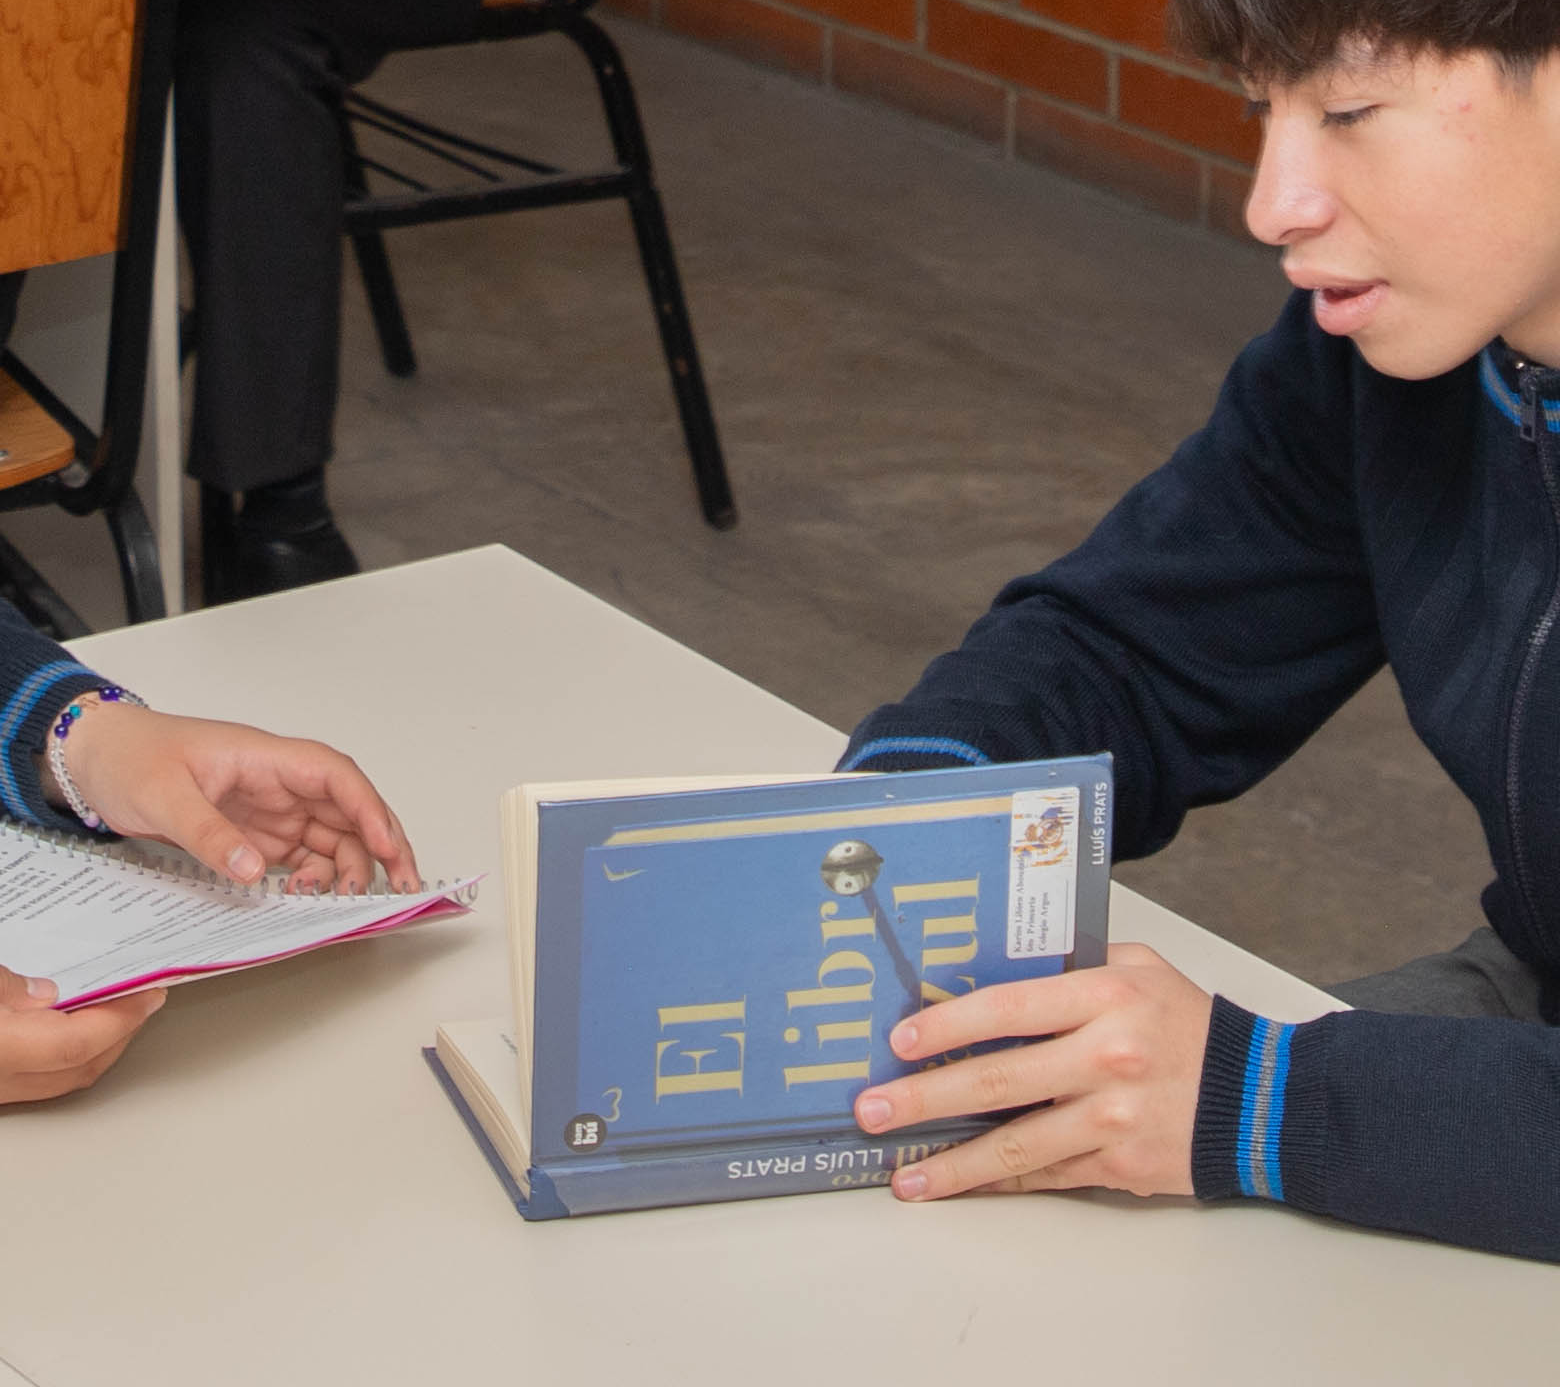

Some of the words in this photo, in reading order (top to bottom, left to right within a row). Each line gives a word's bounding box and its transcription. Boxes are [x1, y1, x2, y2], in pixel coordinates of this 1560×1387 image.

[1093, 781, 1108, 826] PRATS
[1090, 827, 1106, 865] LLUÍS
[1026, 895, 1037, 935] Primaria
[1038, 919, 1049, 952] Colegio
[654, 994, 746, 1106] El
[727, 1155, 807, 1180] PRATS
[815, 1148, 884, 1173] LLUÍS
